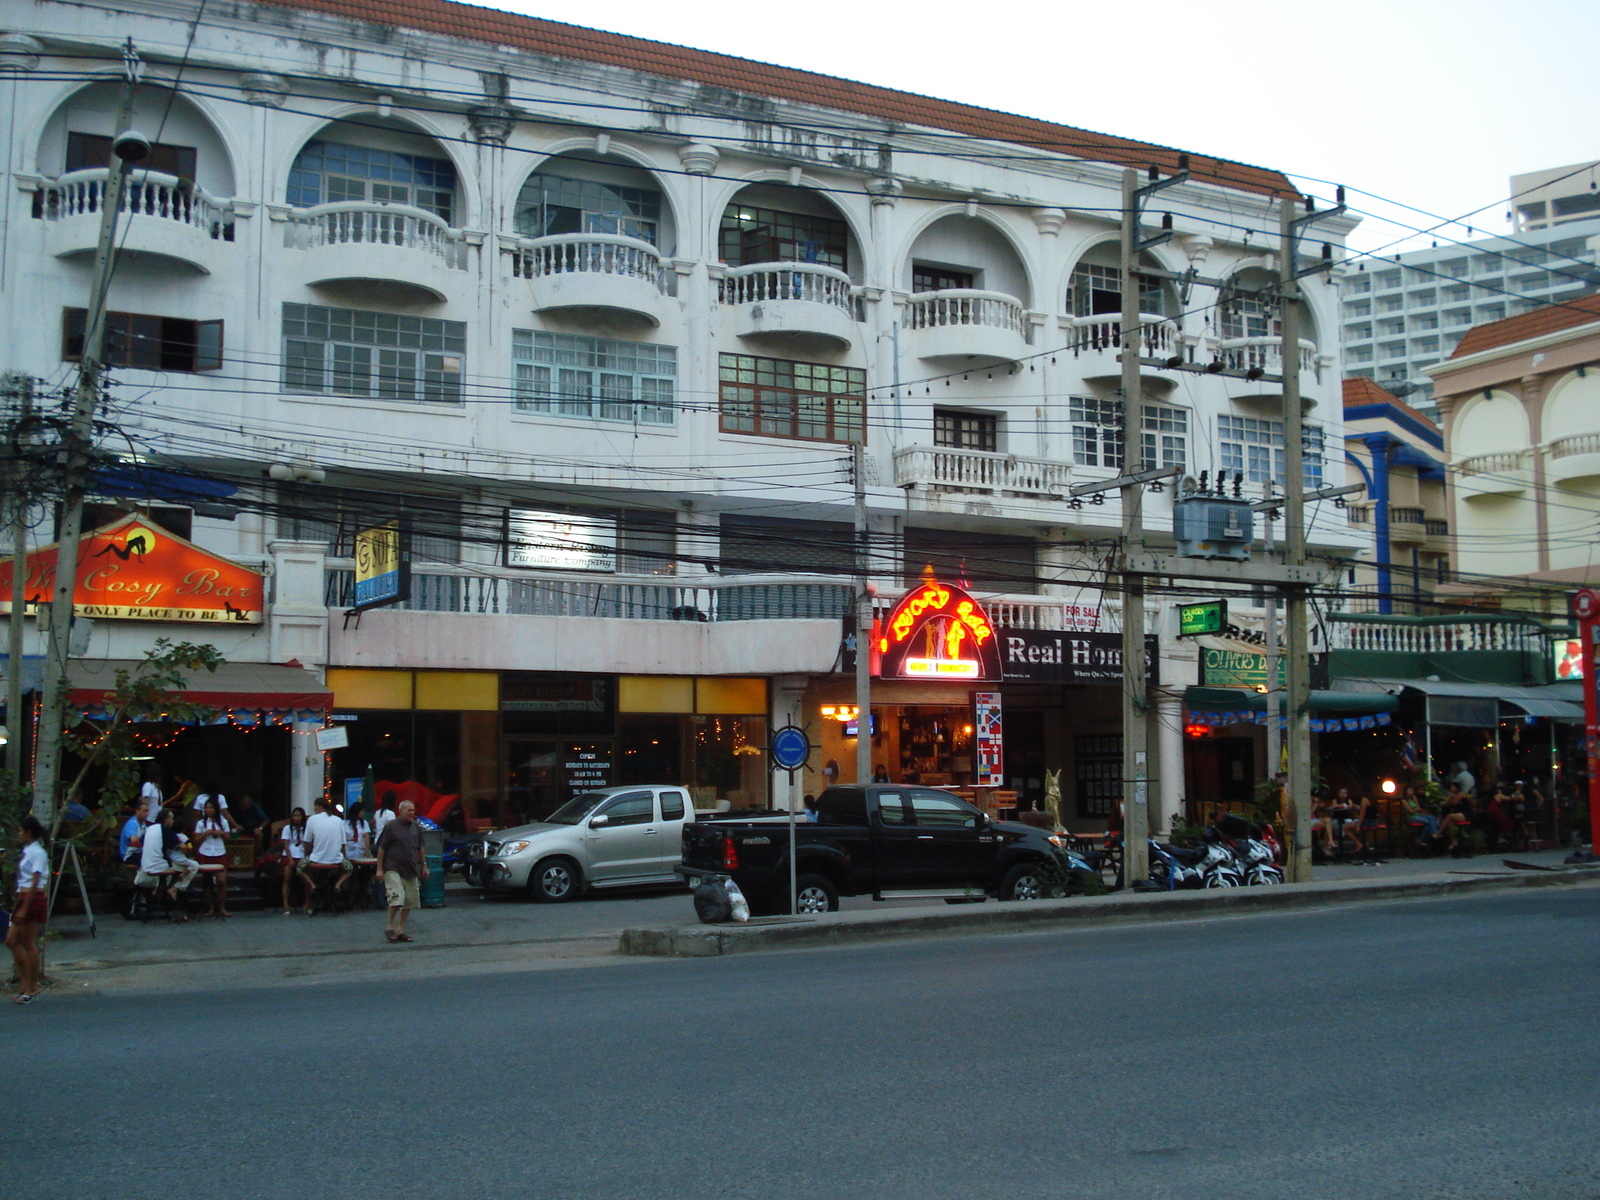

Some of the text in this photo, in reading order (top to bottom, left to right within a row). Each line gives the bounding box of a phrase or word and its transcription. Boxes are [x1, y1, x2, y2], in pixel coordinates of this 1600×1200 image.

[511, 551, 612, 568] Furniture Company
[83, 564, 170, 605] Cosy
[176, 568, 256, 597] Bar
[83, 606, 121, 616] ONLY
[128, 607, 173, 619] PLACE
[178, 609, 195, 620] TO
[201, 610, 219, 620] BE
[1066, 606, 1100, 618] FOR SALE
[1006, 637, 1151, 666] Real Homs
